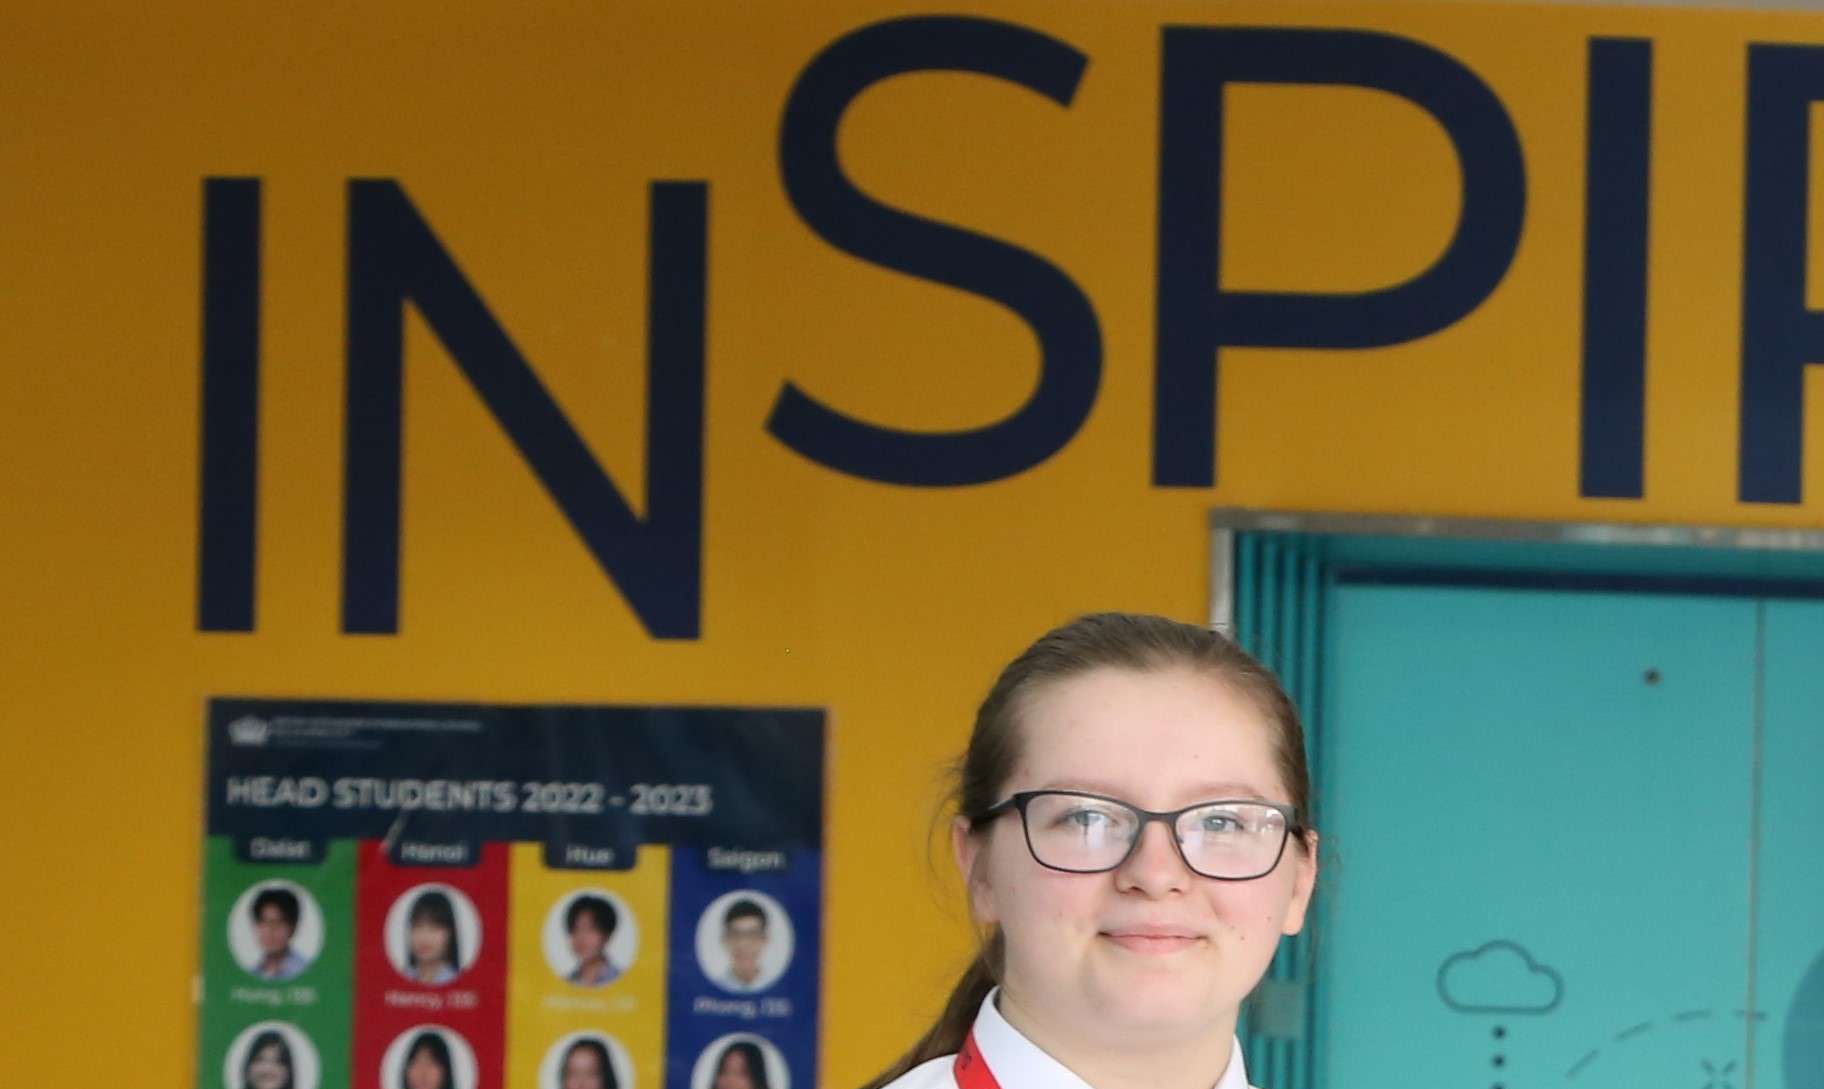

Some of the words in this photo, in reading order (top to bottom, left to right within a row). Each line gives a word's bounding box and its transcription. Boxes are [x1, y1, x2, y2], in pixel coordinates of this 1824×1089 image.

[226, 777, 330, 807] HEAD
[333, 777, 520, 811] STUDENTS
[521, 781, 602, 813] 2022
[628, 783, 712, 815] 2023
[400, 842, 467, 864] Hanoi
[706, 848, 784, 873] Saigon
